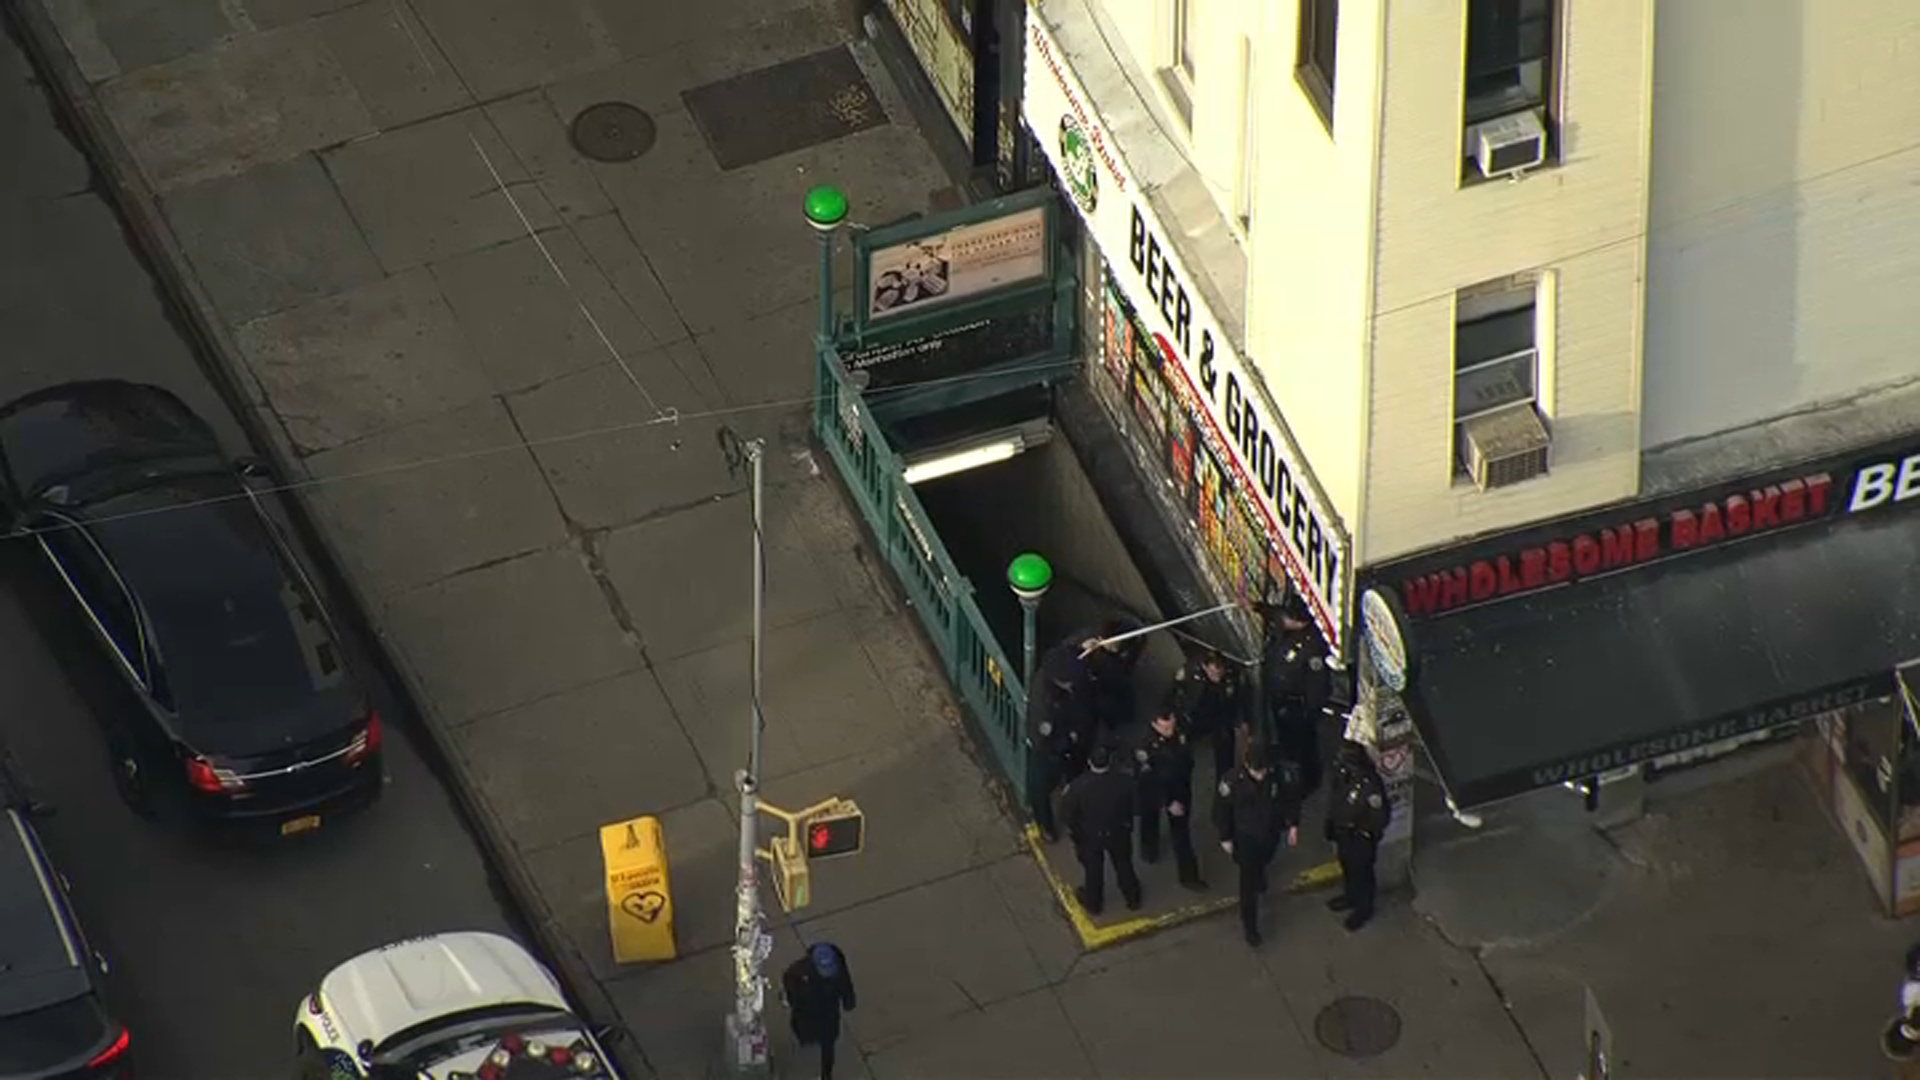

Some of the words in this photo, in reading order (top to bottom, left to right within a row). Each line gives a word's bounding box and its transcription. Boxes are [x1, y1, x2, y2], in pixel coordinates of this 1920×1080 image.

[1130, 201, 1192, 360] BEER
[1199, 328, 1217, 404] &
[1226, 371, 1338, 606] GROCERY
[1406, 517, 1661, 614] WHOLESOME
[1671, 473, 1832, 549] BASKET
[1533, 718, 1738, 785] WHOLESOME
[1745, 686, 1869, 731] BASKET
